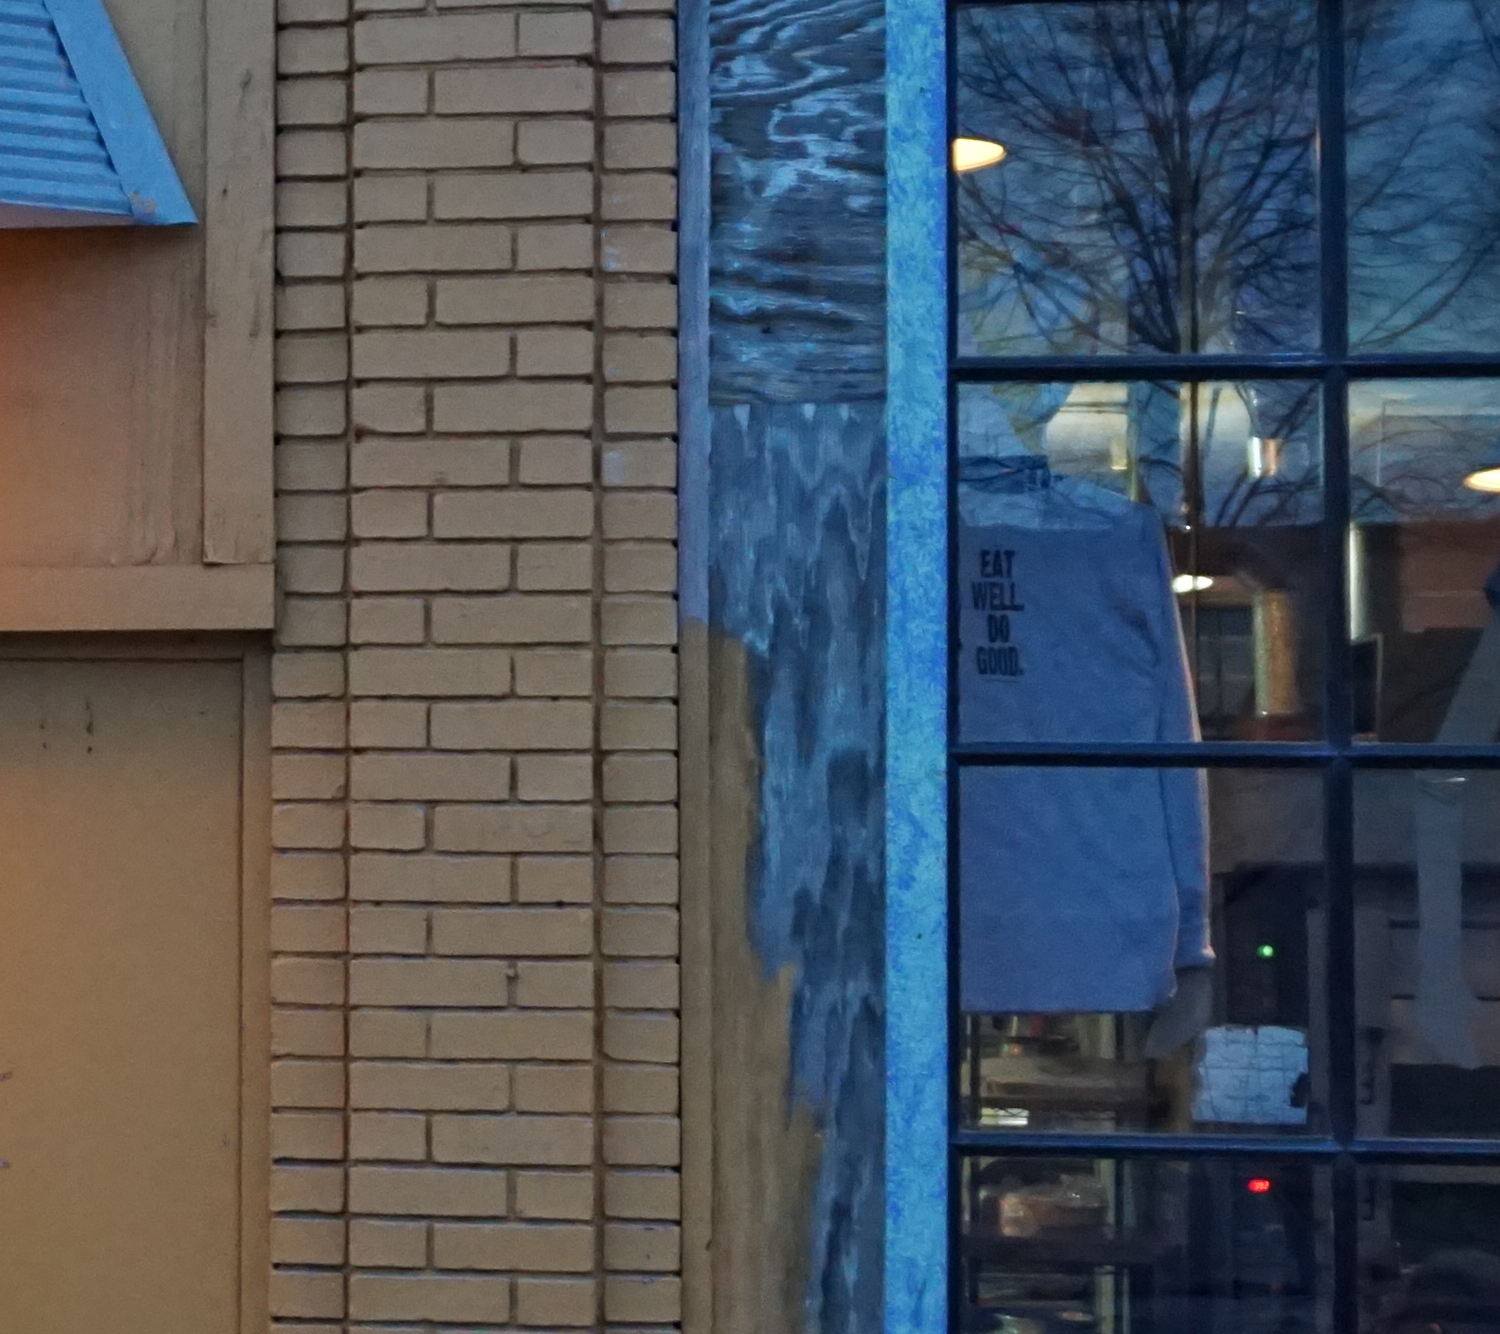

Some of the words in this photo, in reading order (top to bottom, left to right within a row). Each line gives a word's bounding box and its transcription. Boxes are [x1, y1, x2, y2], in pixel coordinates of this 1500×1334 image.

[980, 549, 1016, 578] EAT
[987, 613, 1011, 643] DO
[976, 645, 1025, 676] GOOD.
